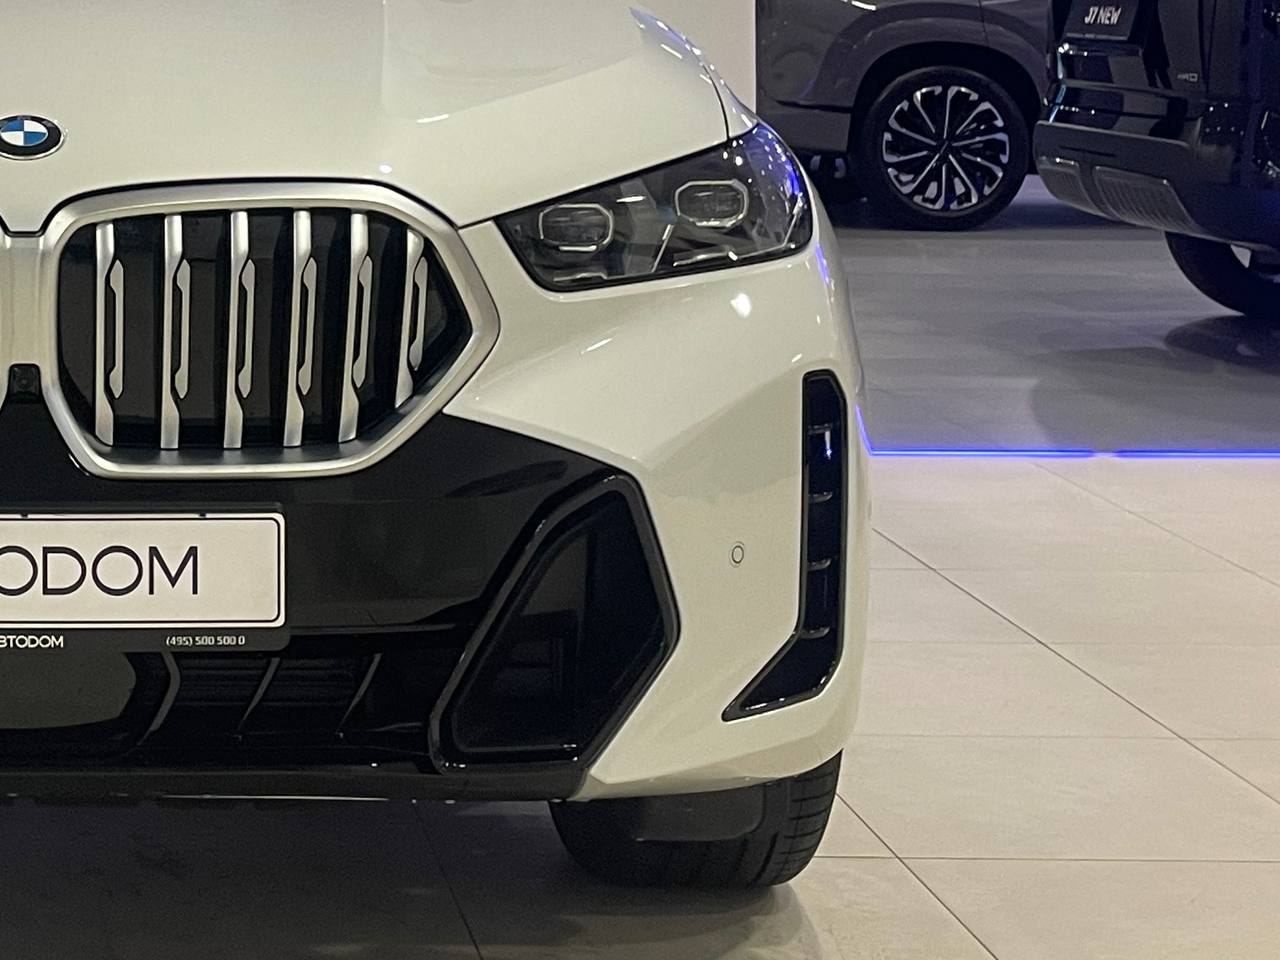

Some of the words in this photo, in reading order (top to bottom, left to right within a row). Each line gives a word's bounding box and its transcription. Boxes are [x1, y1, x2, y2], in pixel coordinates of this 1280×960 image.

[1096, 4, 1122, 25] NEW
[166, 635, 193, 647] (495)
[195, 635, 215, 646] 500
[217, 635, 237, 646] 500
